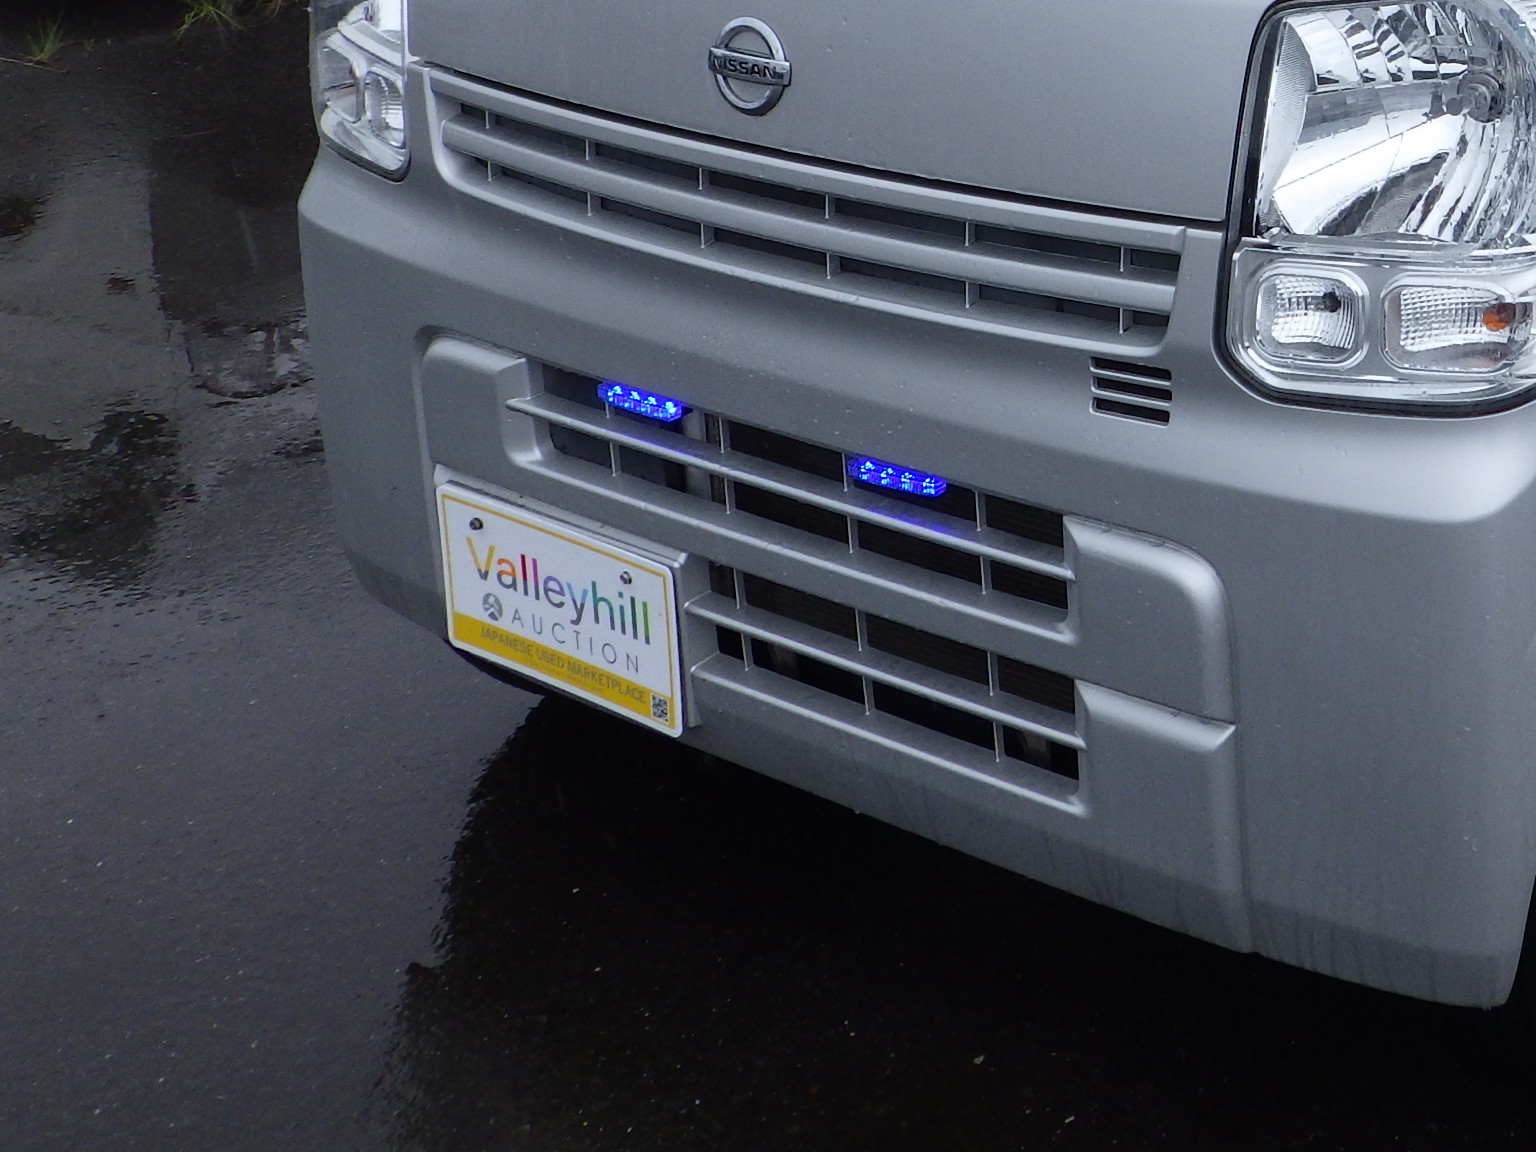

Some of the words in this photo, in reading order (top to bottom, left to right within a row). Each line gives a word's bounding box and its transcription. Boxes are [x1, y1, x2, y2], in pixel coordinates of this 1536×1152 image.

[713, 54, 777, 80] NISSAN
[465, 536, 650, 645] Valleyhill
[480, 626, 533, 657] JAPANESE
[536, 647, 565, 669] USED
[566, 660, 647, 705] MARKETPLACE
[511, 608, 639, 674] AUCTION
